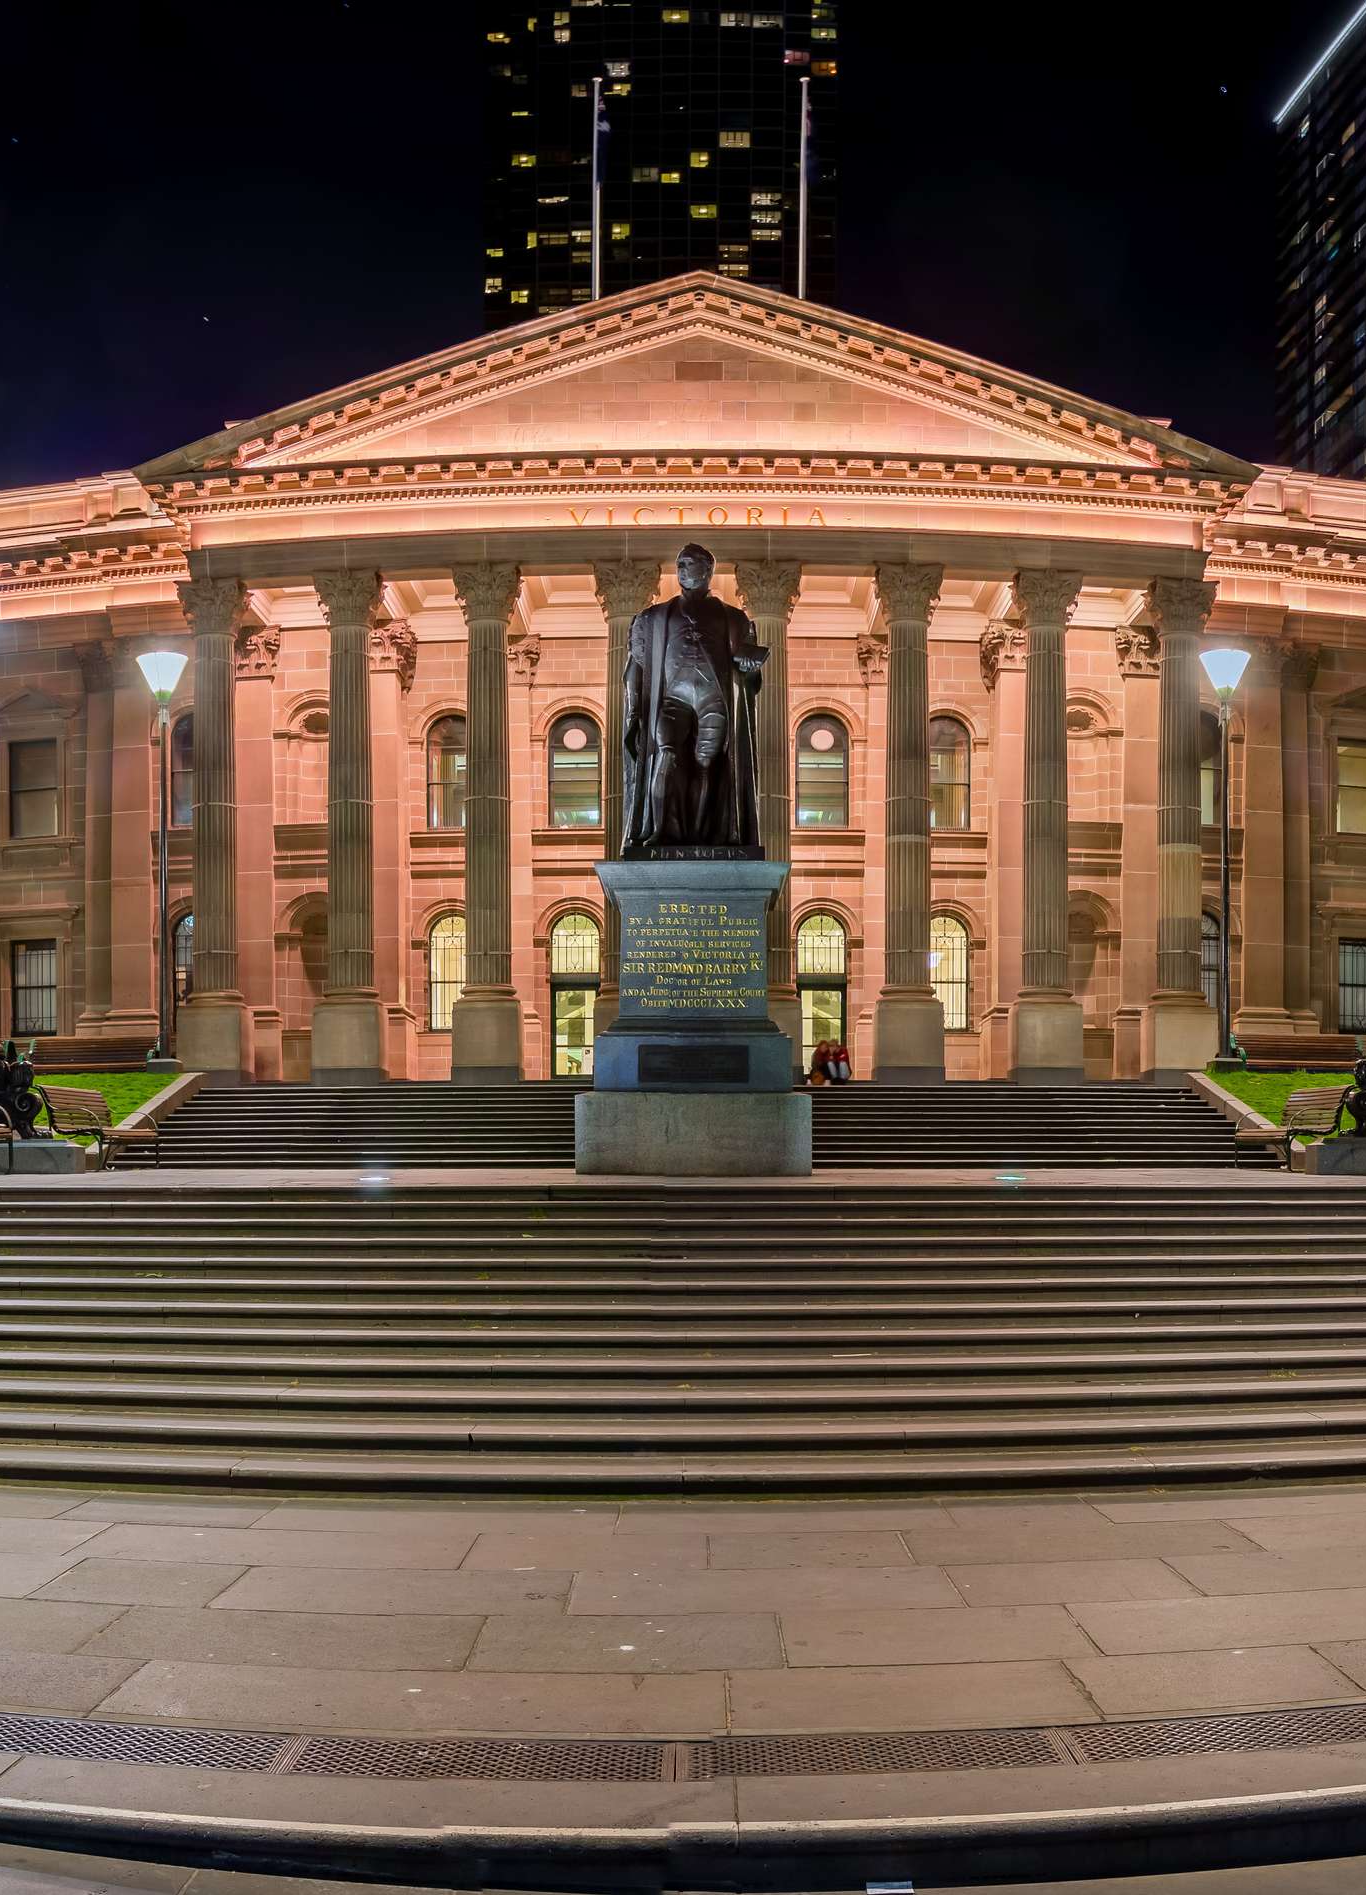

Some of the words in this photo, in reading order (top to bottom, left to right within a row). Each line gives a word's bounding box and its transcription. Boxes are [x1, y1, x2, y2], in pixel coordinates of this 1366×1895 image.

[566, 506, 828, 528] VICTORIA
[658, 903, 729, 915] ERECTED
[645, 917, 654, 926] A
[626, 928, 638, 937] TO
[701, 928, 720, 937] THE
[722, 928, 761, 937] MEMORY
[635, 940, 646, 948] OF
[708, 940, 752, 948] SERVICES
[627, 951, 677, 959] RENDERED
[691, 949, 746, 959] VICTORIA
[749, 951, 761, 959] BY
[622, 962, 645, 974] SIR
[648, 962, 704, 975] REDMOND
[705, 962, 748, 974] BARRY
[655, 975, 688, 986] DOCOR
[704, 975, 732, 986] LAWS
